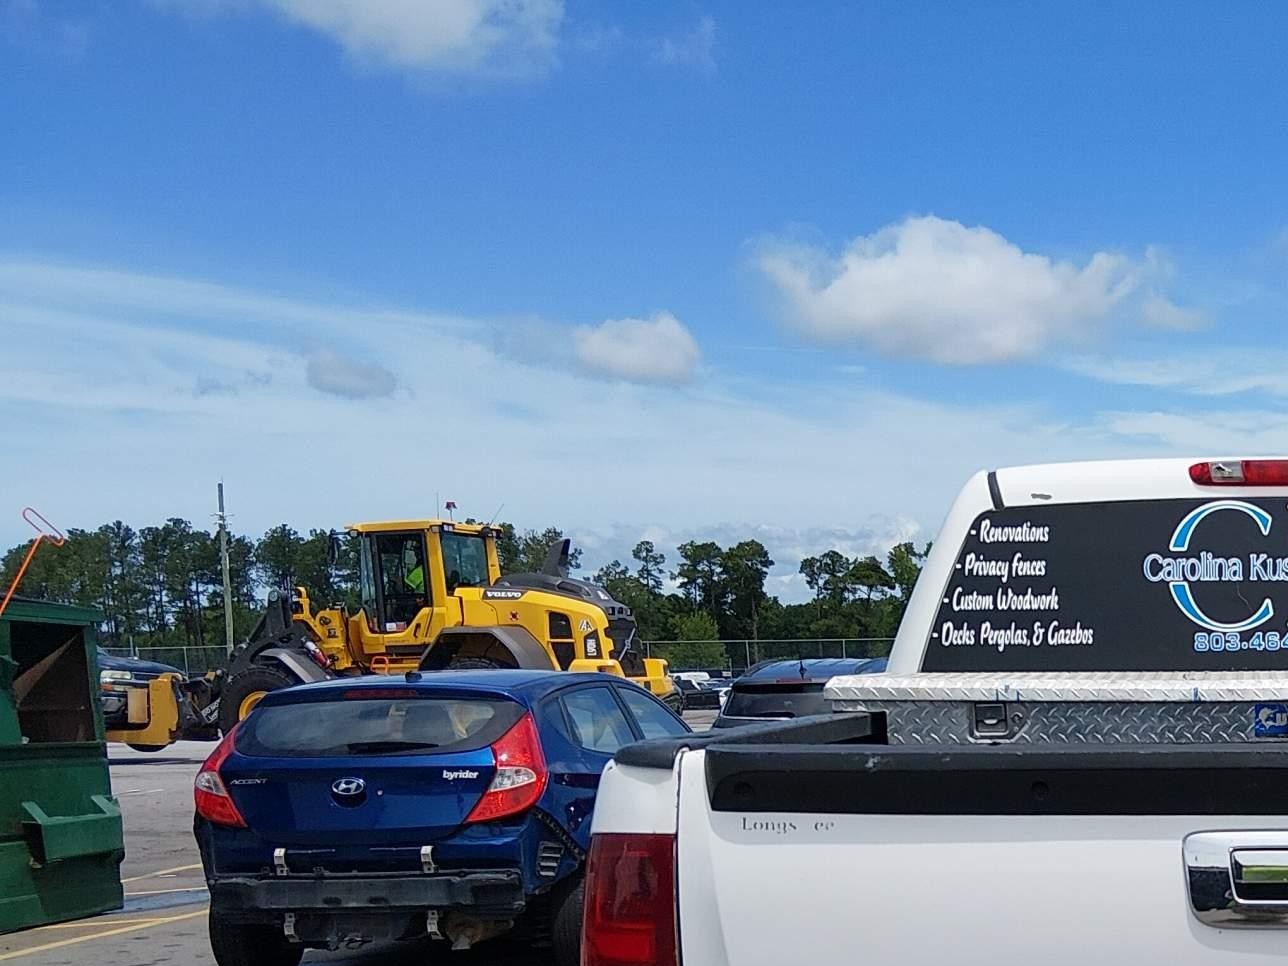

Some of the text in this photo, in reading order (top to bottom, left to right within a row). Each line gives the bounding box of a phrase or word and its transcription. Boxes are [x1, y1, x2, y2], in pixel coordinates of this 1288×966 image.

[980, 519, 1049, 543] Renovations
[965, 552, 1009, 583] Privacy
[1012, 553, 1046, 577] fences
[1144, 552, 1243, 581] Carolina
[952, 587, 994, 611] Custom
[997, 587, 1059, 610] Woodwork
[941, 622, 975, 646] Decks
[980, 621, 1030, 652] Pergolas,
[1033, 622, 1044, 646] &
[1048, 621, 1093, 646] Gazebos
[442, 769, 479, 780] byrider
